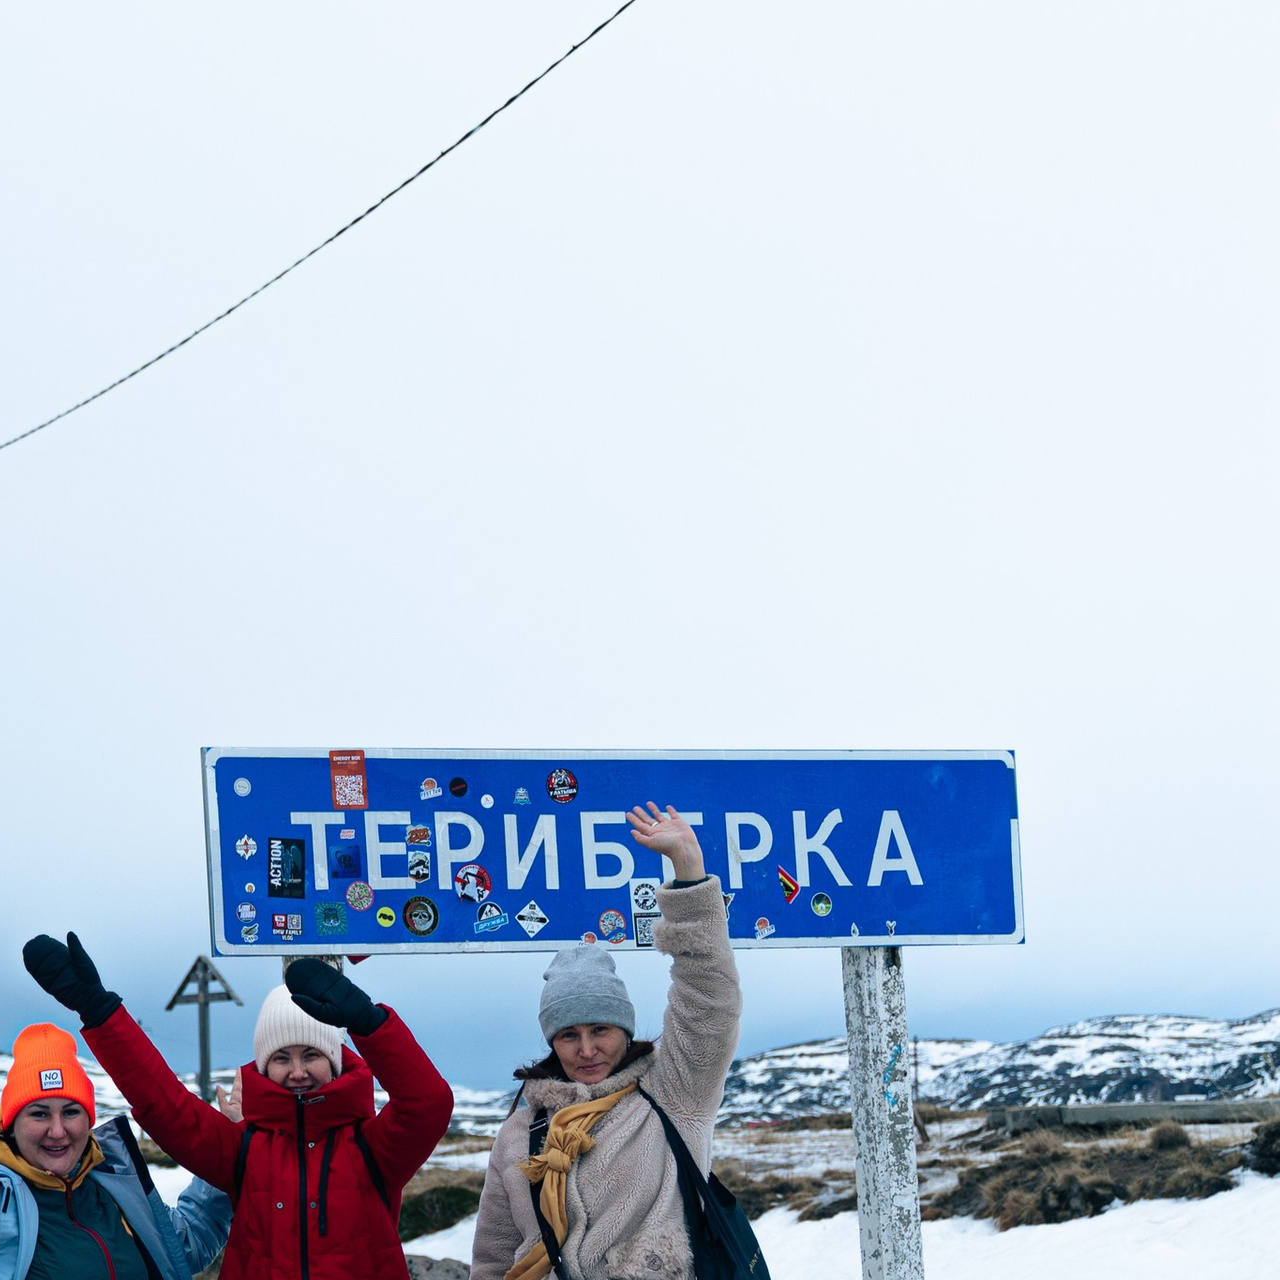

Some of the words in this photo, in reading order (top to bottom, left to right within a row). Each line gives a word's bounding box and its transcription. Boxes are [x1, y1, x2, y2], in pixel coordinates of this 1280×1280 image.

[290, 808, 924, 891] ТЕРИБРКА
[478, 917, 505, 930] ДРУЖБА
[45, 1072, 59, 1081] NO
